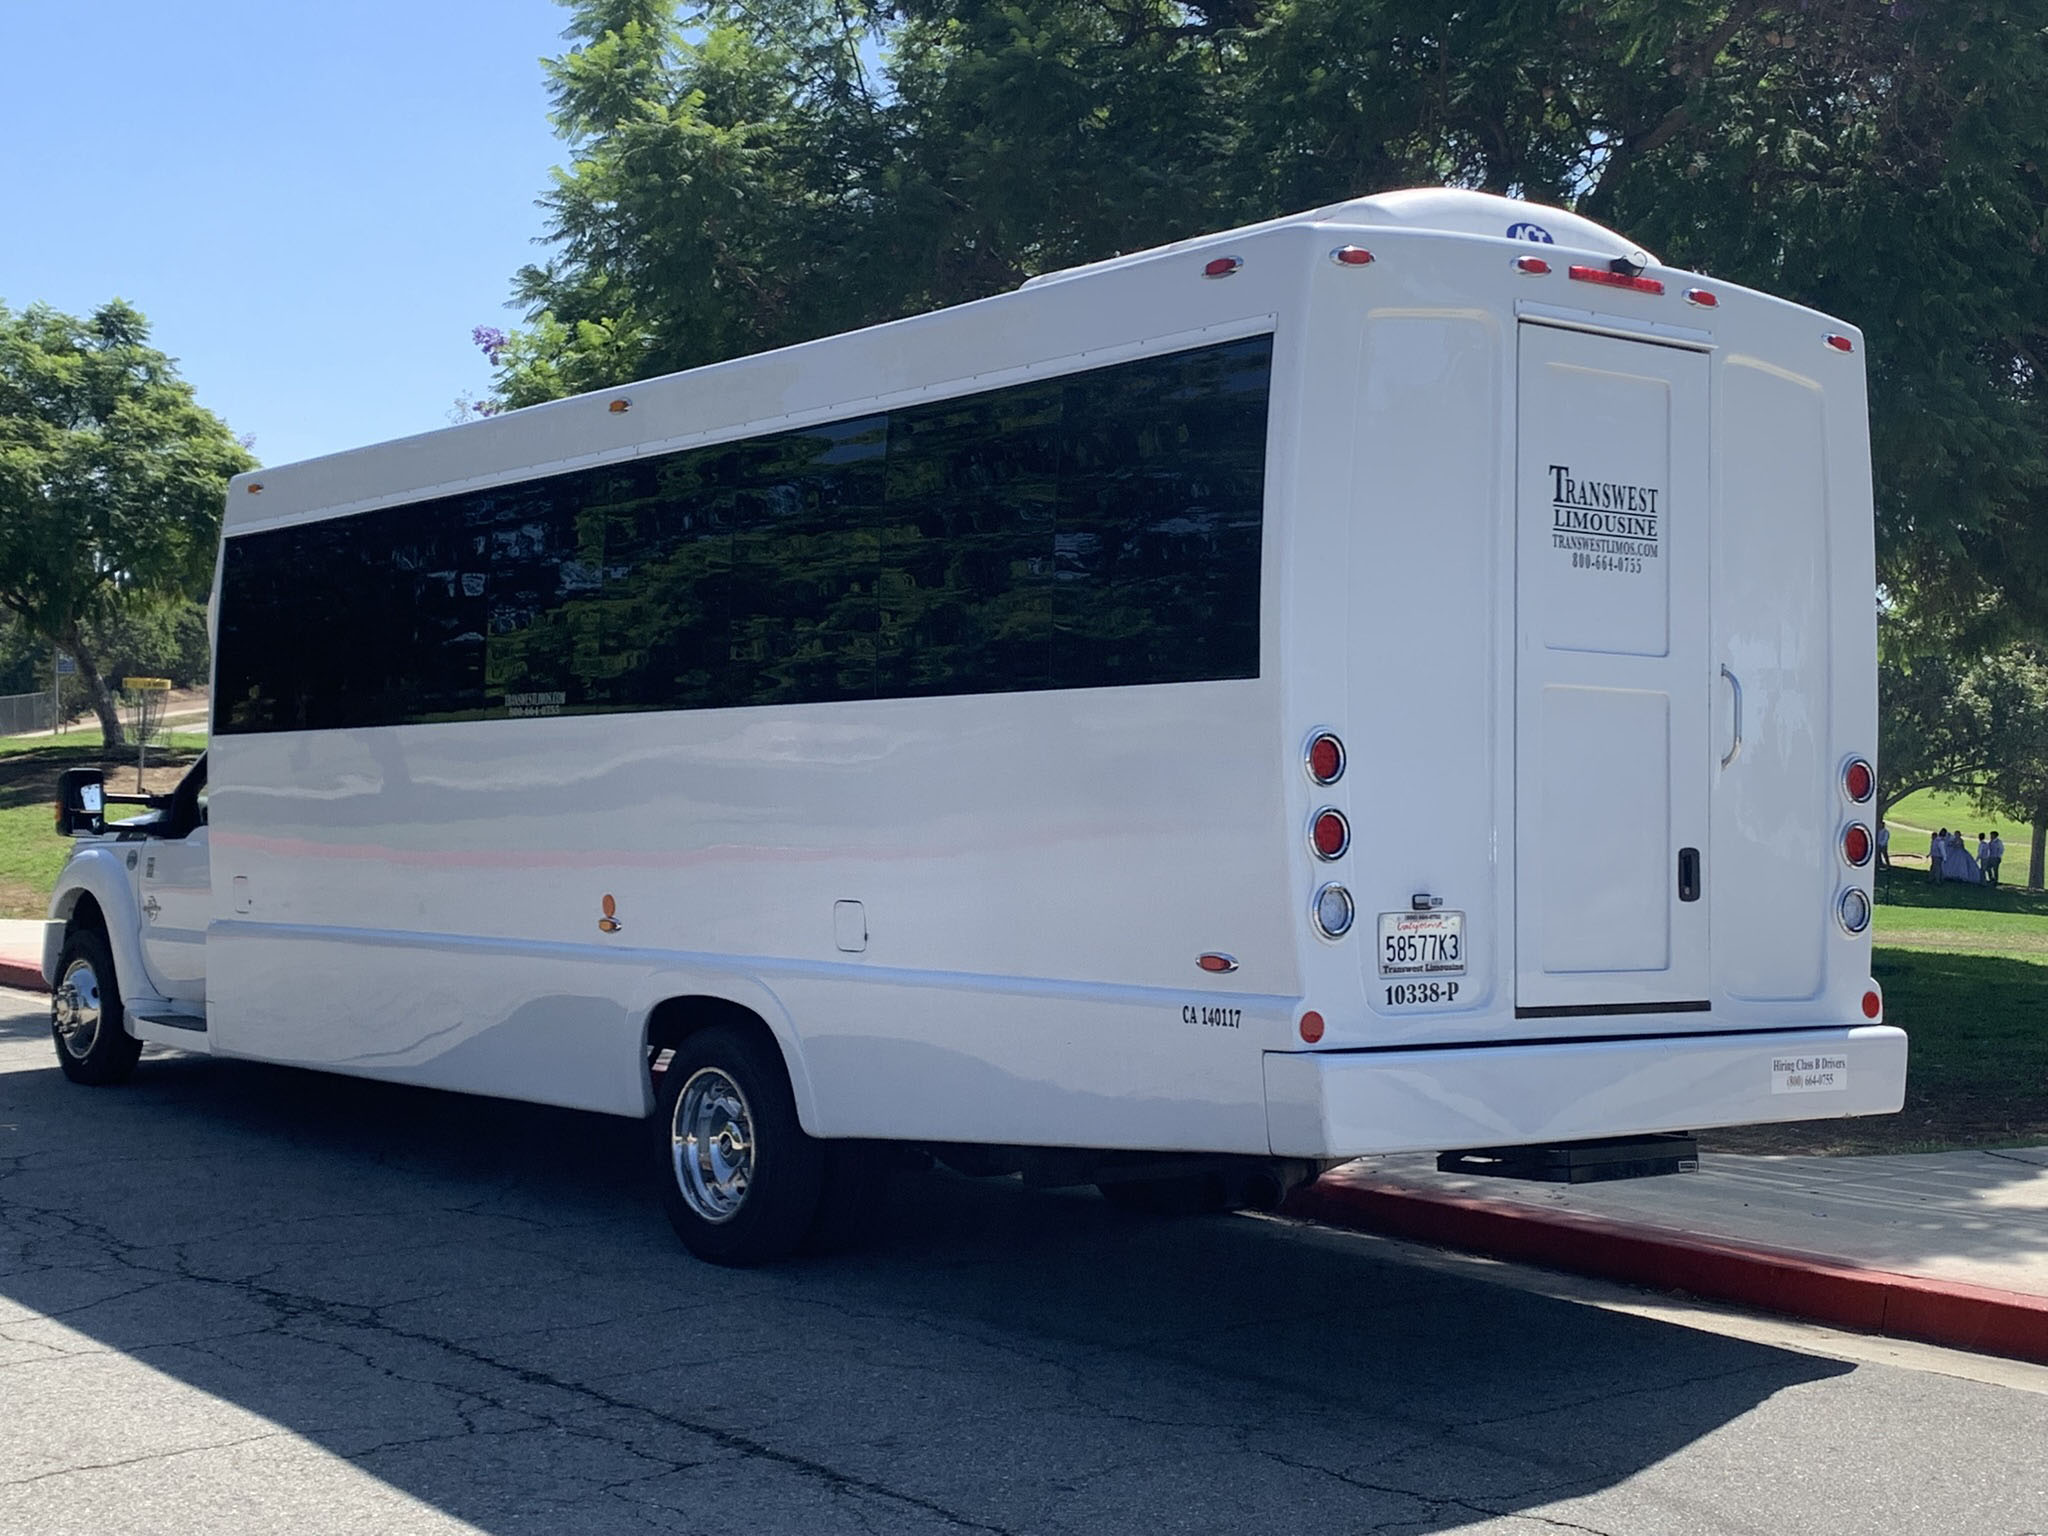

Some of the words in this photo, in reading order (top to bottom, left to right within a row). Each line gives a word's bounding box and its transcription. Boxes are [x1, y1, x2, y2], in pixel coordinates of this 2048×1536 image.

[1548, 464, 1659, 514] TRANSWEST
[1553, 509, 1658, 537] LIMOUSINE
[1552, 534, 1658, 558] TRANSWESTLIMOS.COM
[1572, 552, 1642, 574] 800-664-0755
[1386, 934, 1459, 962] 58577K3
[1383, 965, 1423, 975] Transwest
[1385, 981, 1460, 1006] 10338-P
[1182, 1005, 1198, 1025] CA
[1201, 1006, 1242, 1029] 140117
[1773, 1059, 1795, 1073] Hiring
[1796, 1058, 1814, 1071] Class
[1815, 1058, 1821, 1070] B
[1822, 1057, 1846, 1070] Drivers
